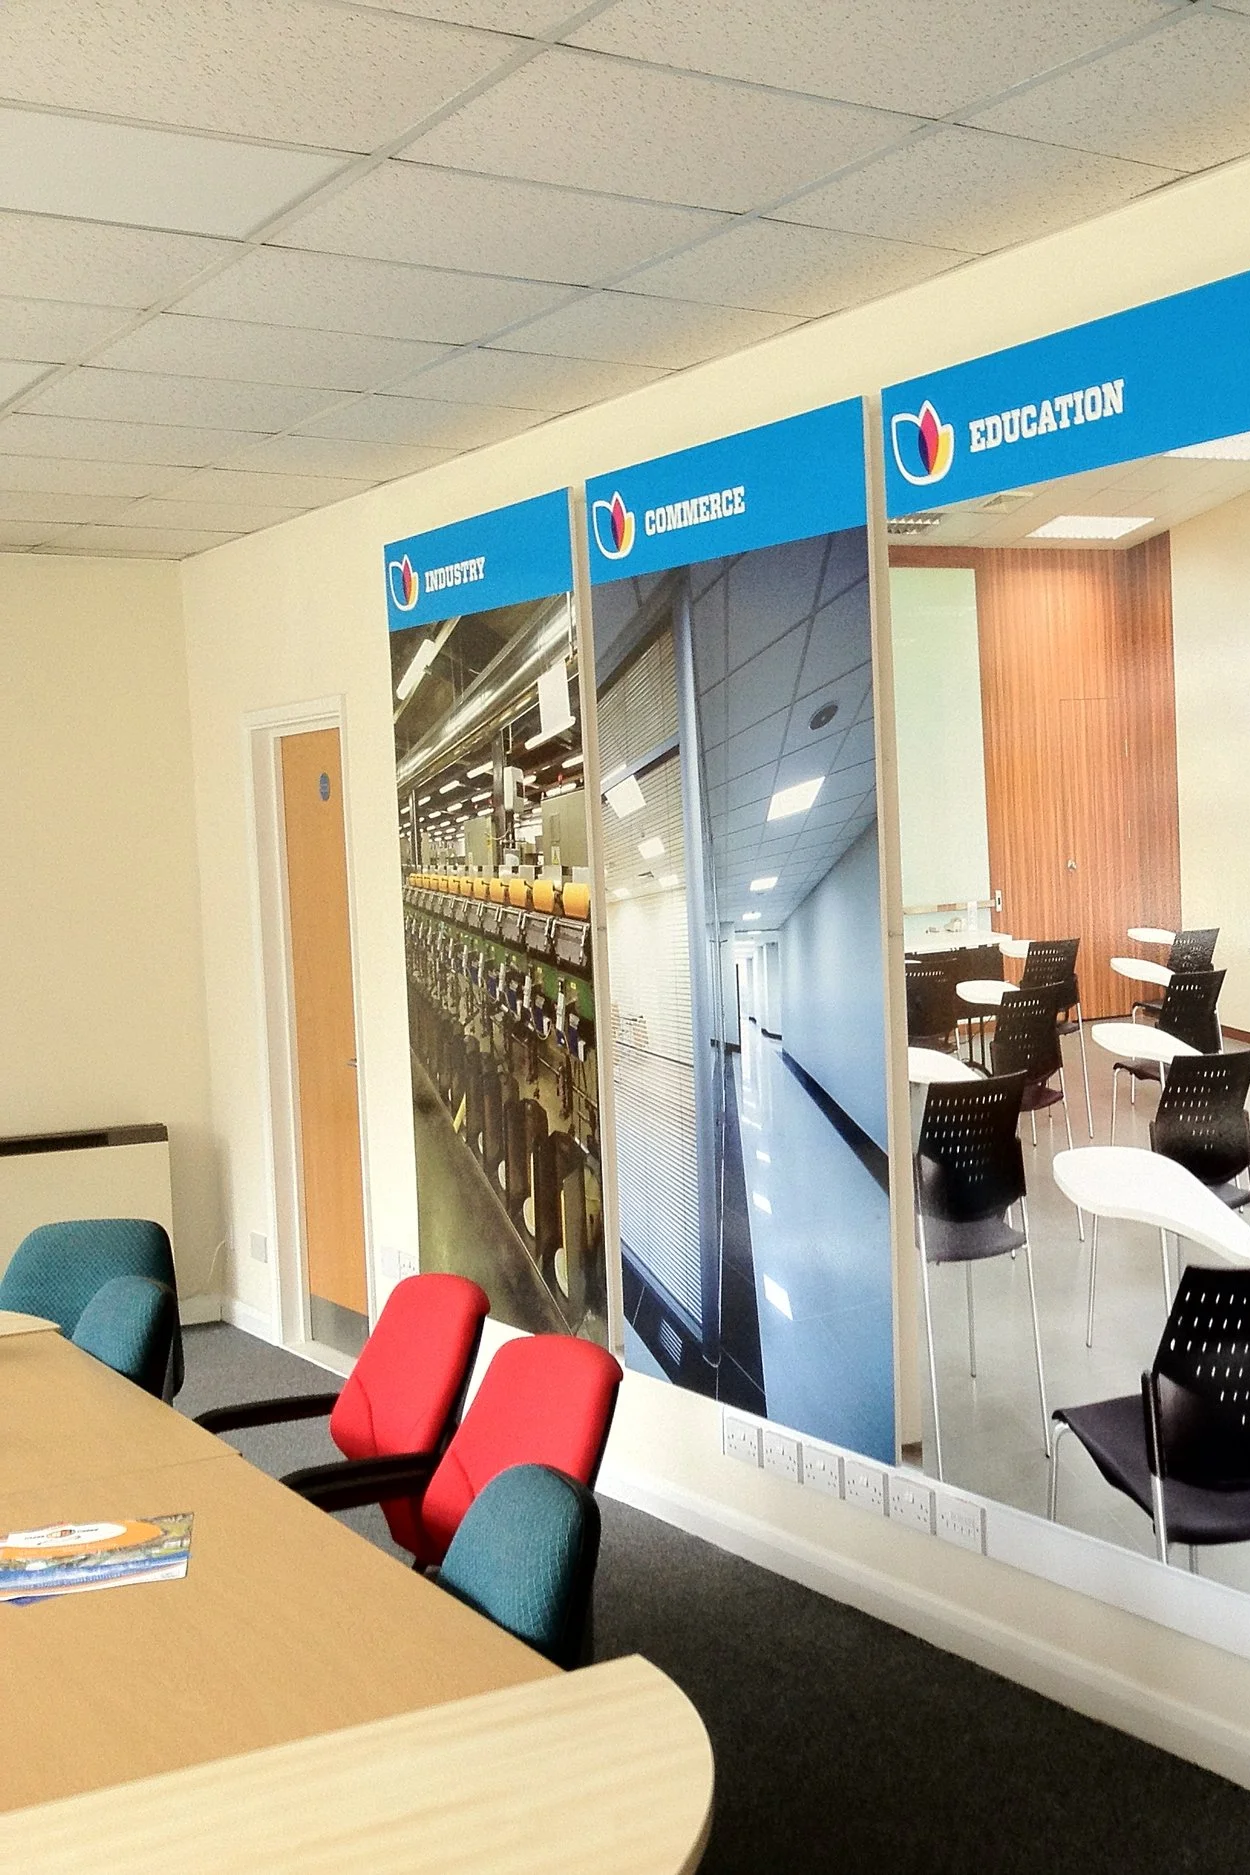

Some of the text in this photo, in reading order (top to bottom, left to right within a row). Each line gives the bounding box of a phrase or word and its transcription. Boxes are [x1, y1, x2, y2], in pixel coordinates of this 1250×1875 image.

[969, 379, 1126, 453] EDUCATION
[645, 486, 746, 536] COMMERCE
[424, 556, 486, 593] INDUSTRY
